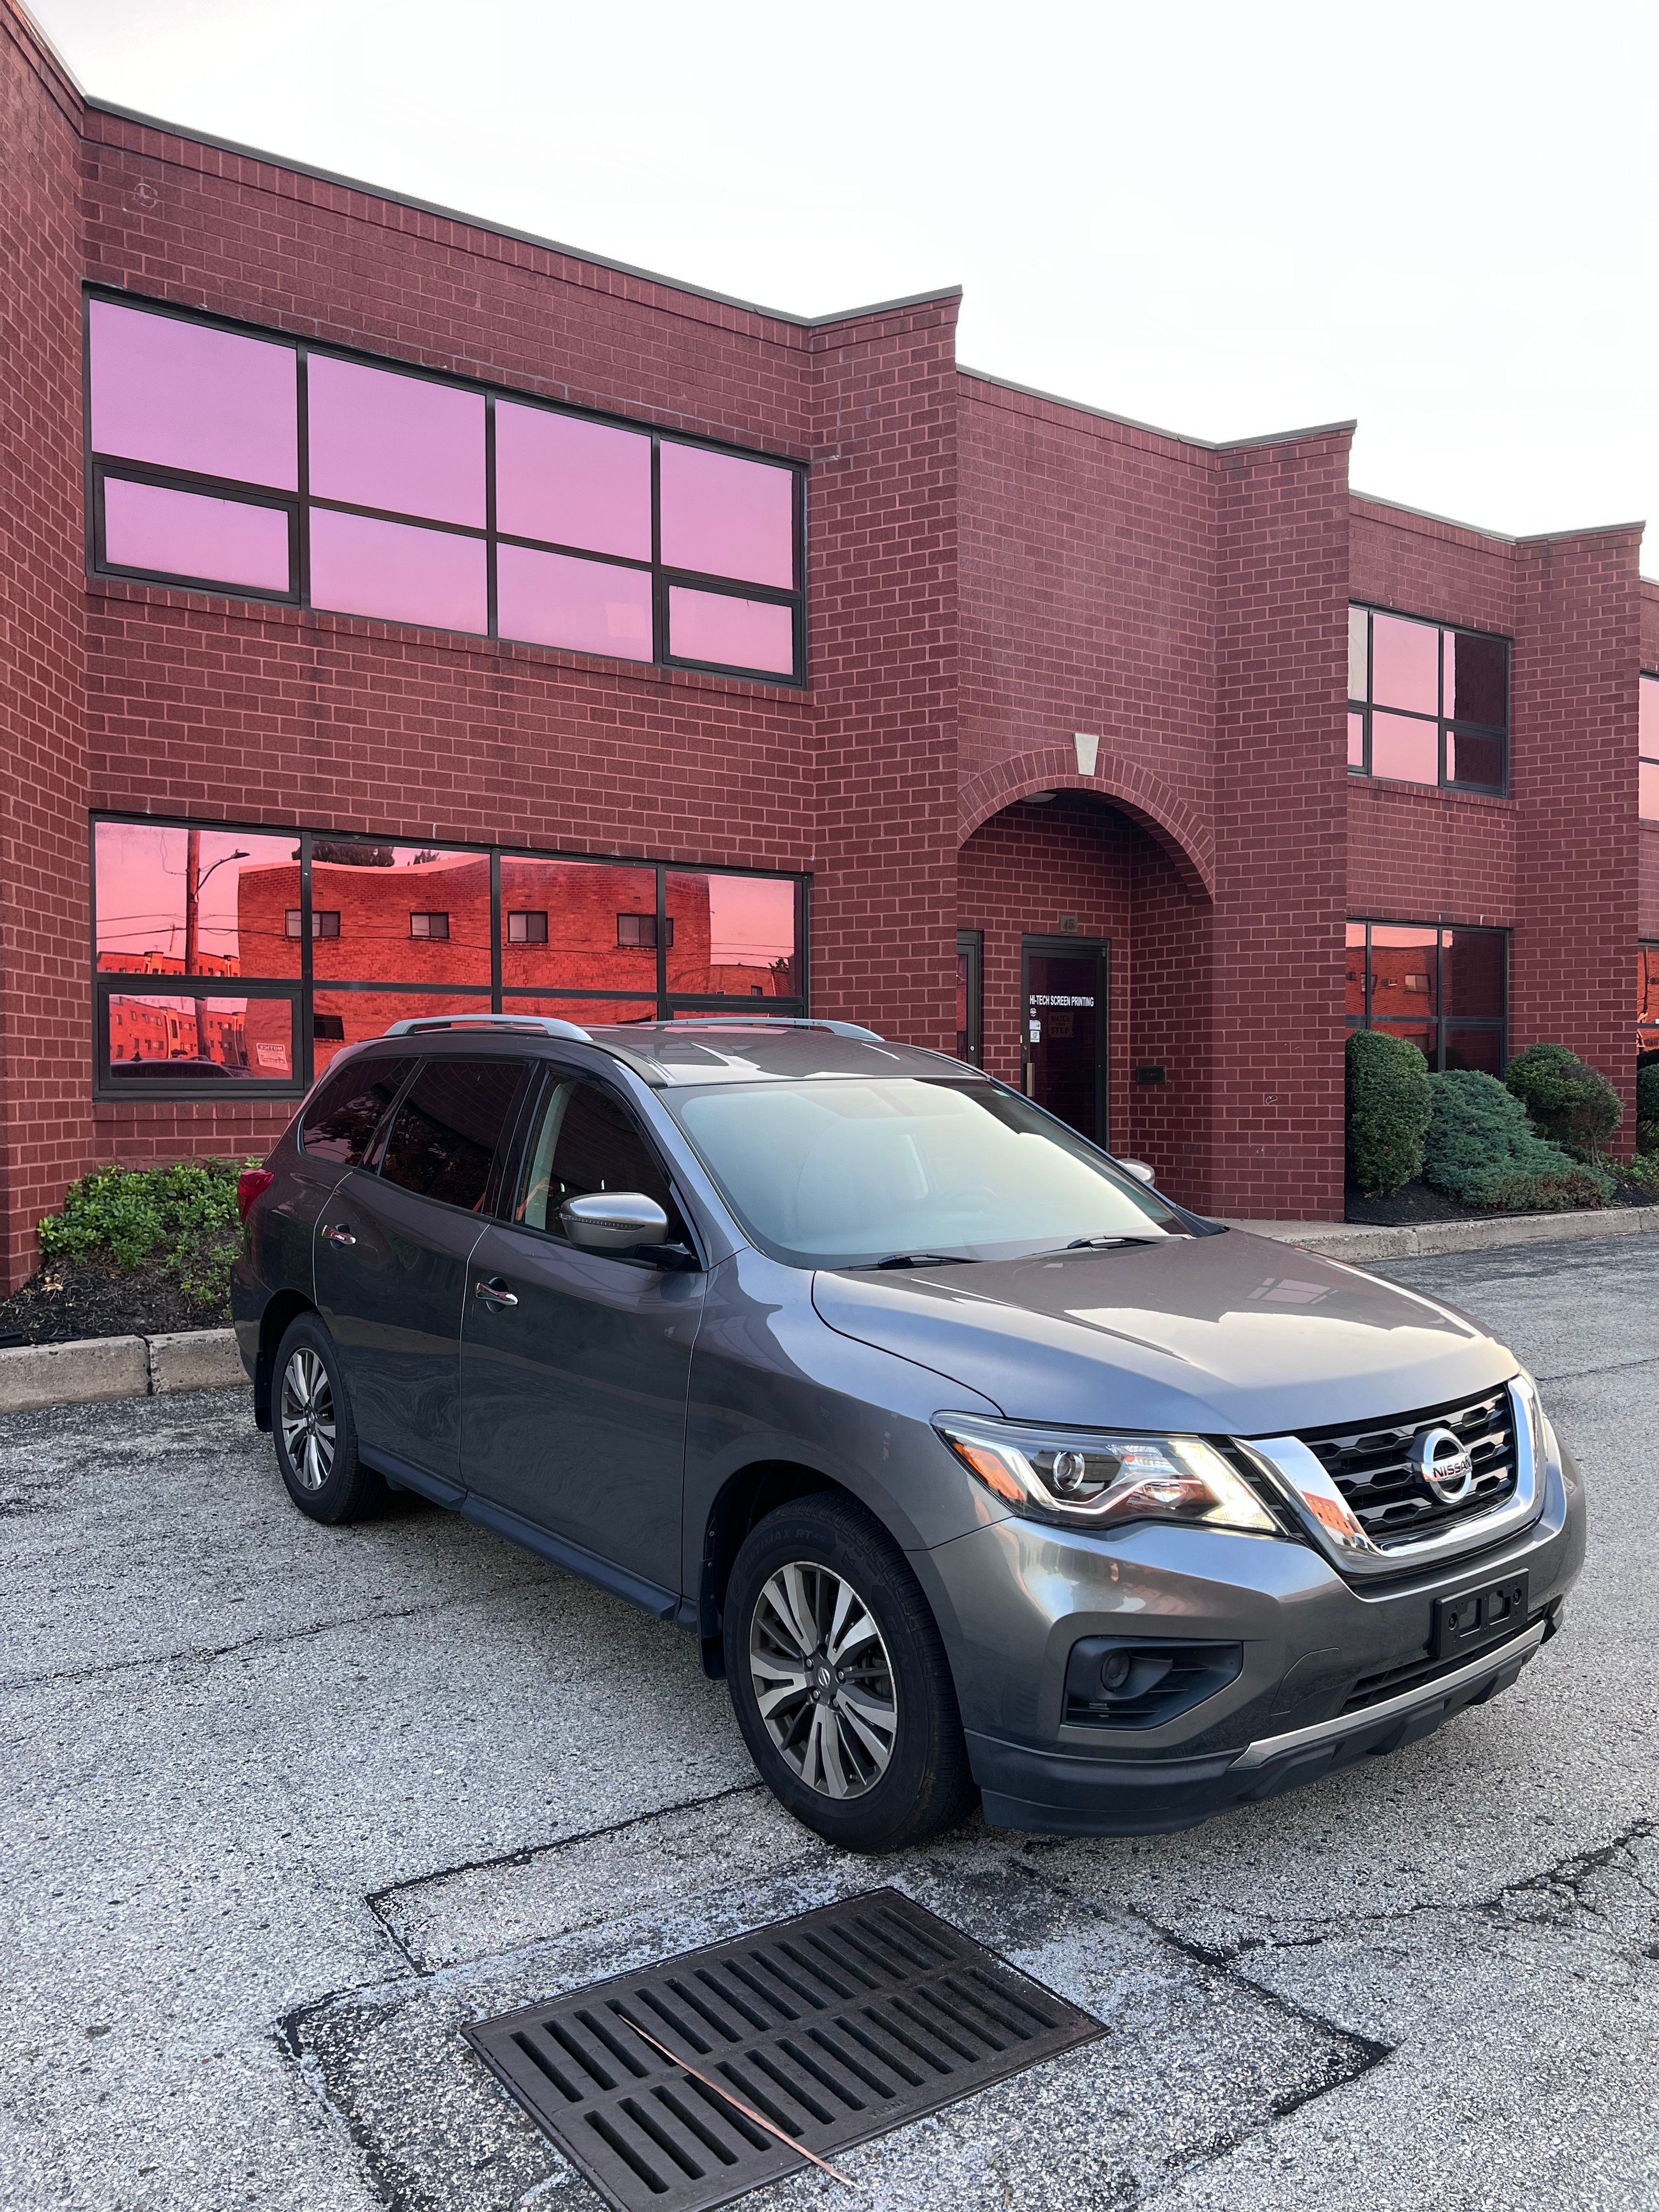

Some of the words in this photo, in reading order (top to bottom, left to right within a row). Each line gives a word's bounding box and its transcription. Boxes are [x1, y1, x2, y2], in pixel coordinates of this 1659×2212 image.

[1029, 995, 1049, 1006] HI-TECH
[1050, 995, 1071, 1006] SCREEN
[1071, 996, 1094, 1007] PRINTING
[1432, 1455, 1471, 1477] NISSAN
[744, 1529, 791, 1570] ALTIMAX
[884, 1615, 919, 1747] GENERAL
[865, 2099, 907, 2119] INDIA
